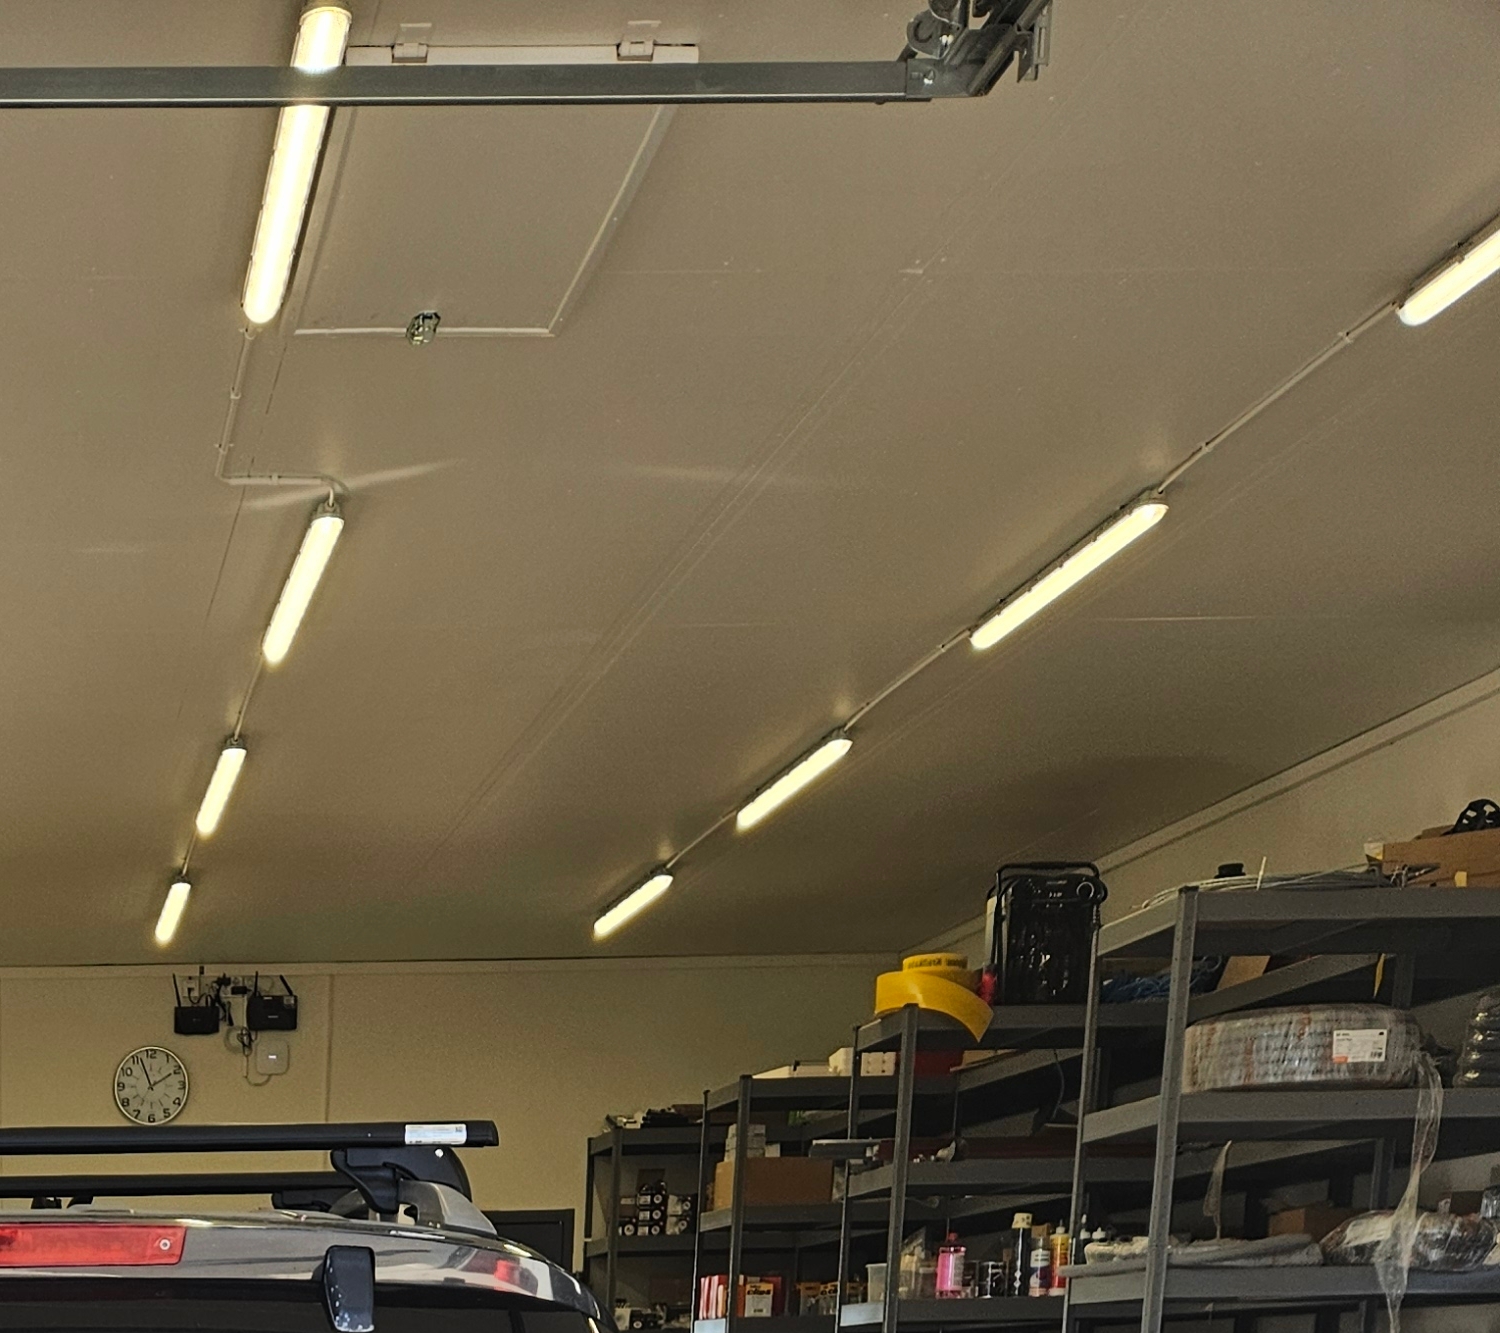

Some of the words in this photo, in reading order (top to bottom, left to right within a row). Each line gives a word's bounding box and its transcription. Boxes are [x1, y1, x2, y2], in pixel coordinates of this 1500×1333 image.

[145, 1049, 157, 1059] 12
[121, 1067, 133, 1077] 10
[173, 1065, 182, 1075] 2
[117, 1082, 125, 1091] 9
[178, 1080, 186, 1090] 3
[121, 1098, 130, 1107] 8
[172, 1097, 181, 1107] 4
[132, 1109, 141, 1119] 7
[162, 1108, 171, 1118] 5
[148, 1114, 156, 1123] 6
